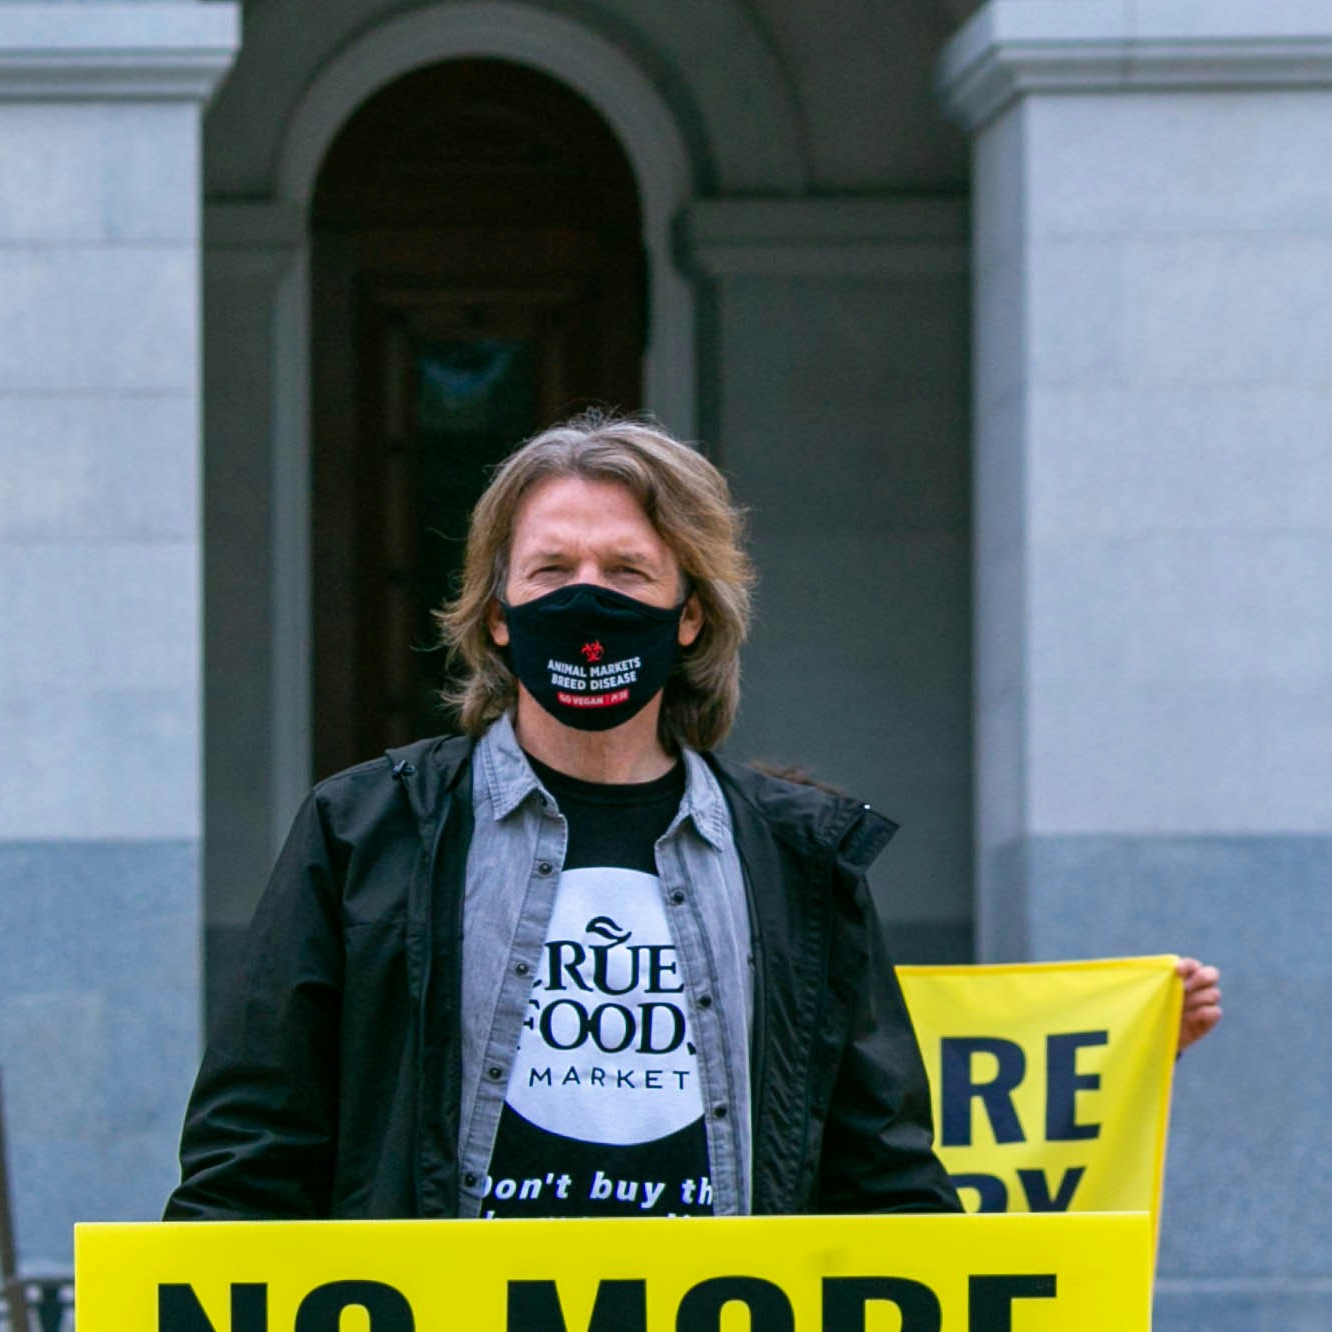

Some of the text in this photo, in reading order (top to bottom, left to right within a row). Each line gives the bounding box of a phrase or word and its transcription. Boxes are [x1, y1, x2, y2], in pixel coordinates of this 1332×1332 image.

[547, 656, 641, 678] ANIMAL MARKETS
[551, 671, 636, 690] BREED DISEASE
[533, 940, 684, 995] RUE
[517, 998, 697, 1055] OOD
[529, 1066, 689, 1090] MARKET
[940, 1030, 1110, 1147] RE
[590, 1171, 665, 1209] buy
[681, 1177, 714, 1205] th
